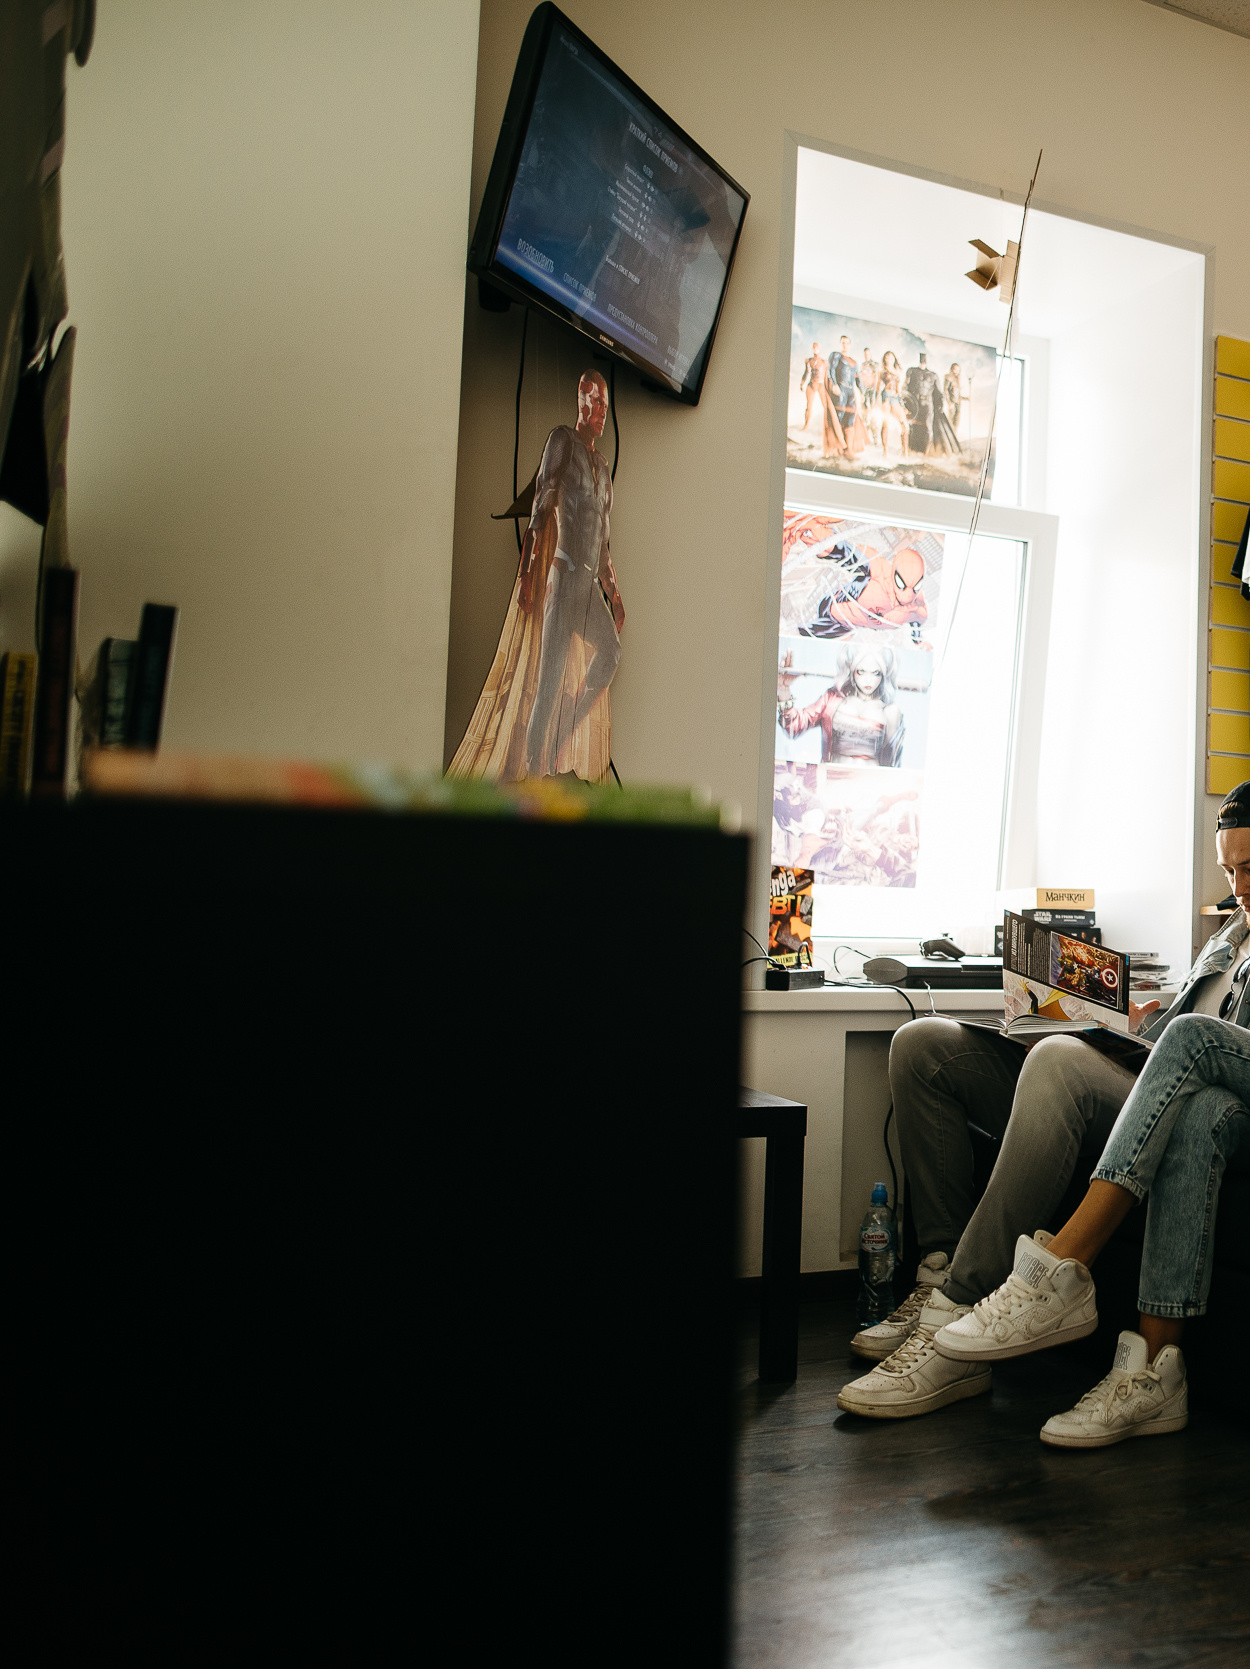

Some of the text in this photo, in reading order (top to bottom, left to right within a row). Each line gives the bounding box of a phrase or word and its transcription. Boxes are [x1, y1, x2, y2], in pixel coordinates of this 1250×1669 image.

[517, 238, 555, 273] ВОЗОБНОВИТЬ
[563, 272, 579, 290] СПИСОК
[770, 869, 797, 897] nga
[1045, 891, 1086, 903] Манчкин
[1015, 1251, 1050, 1290] FORCE
